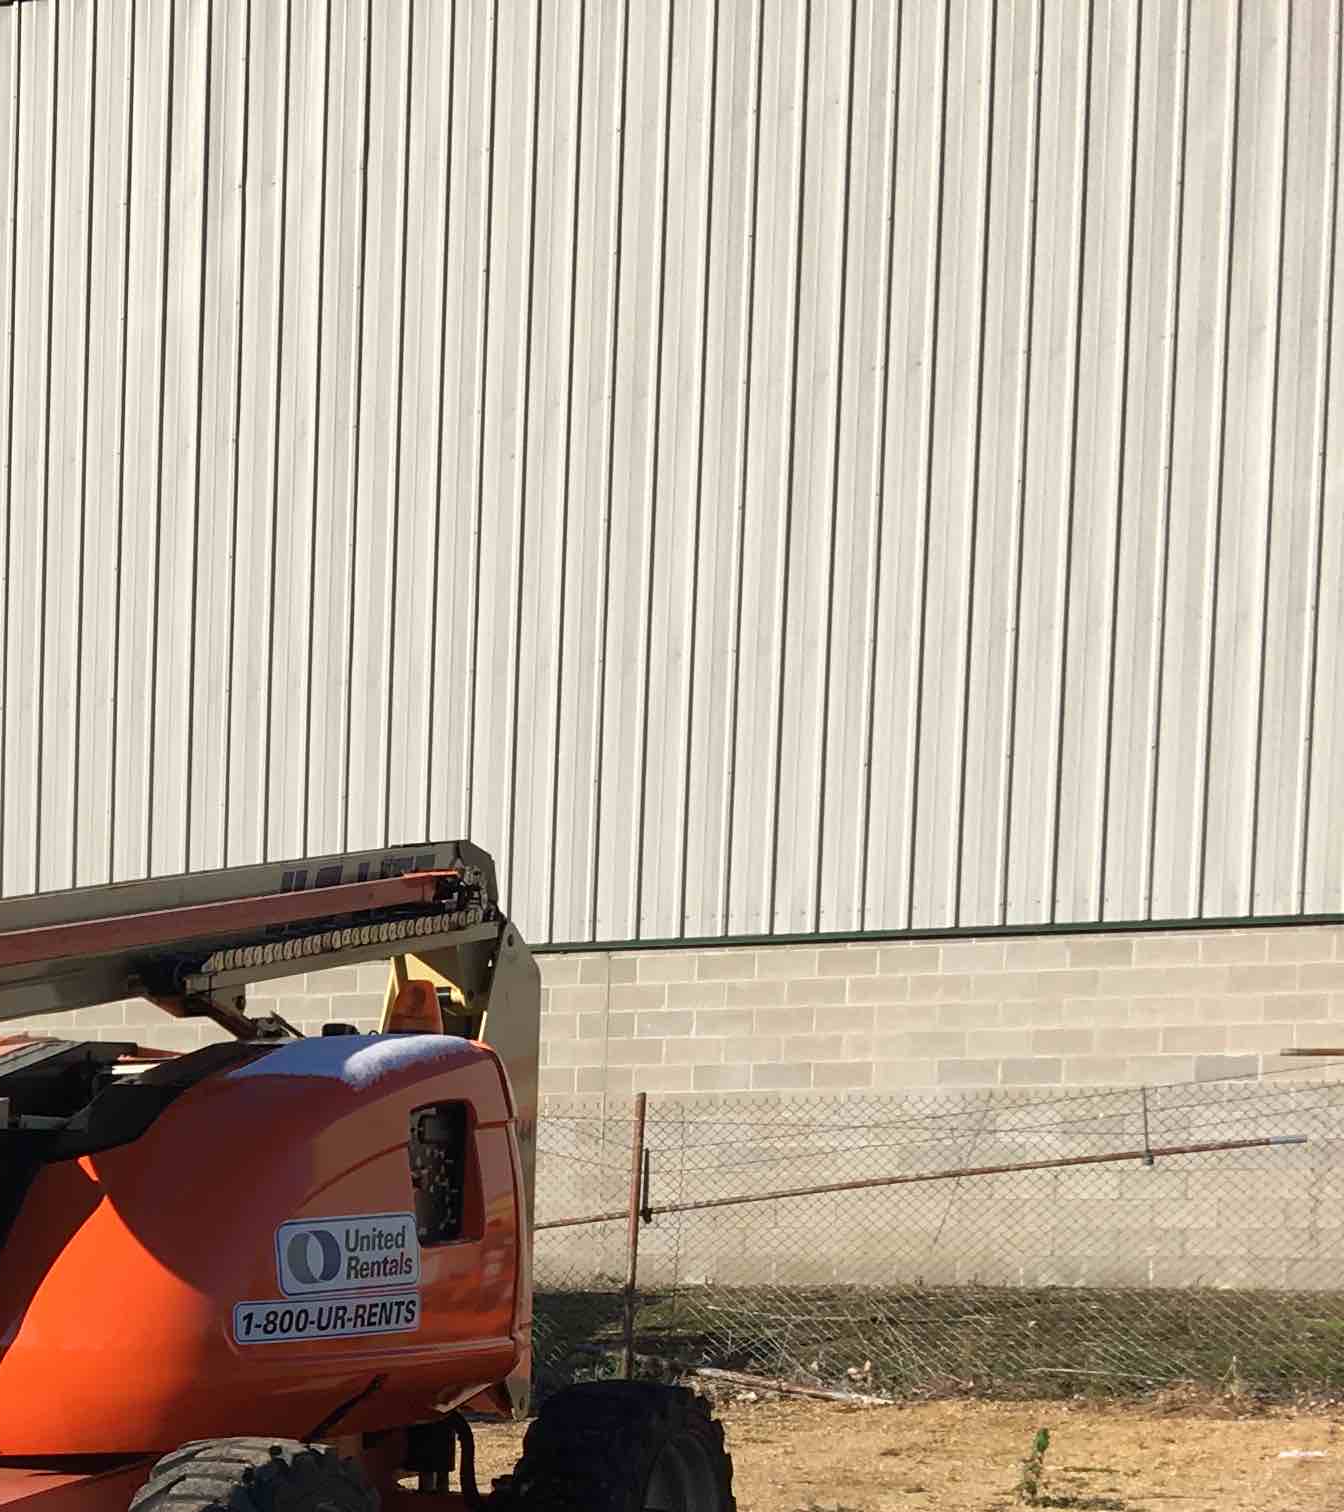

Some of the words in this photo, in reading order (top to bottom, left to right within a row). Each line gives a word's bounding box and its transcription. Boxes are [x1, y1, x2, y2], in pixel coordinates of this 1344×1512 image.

[345, 1225, 406, 1252] United
[345, 1252, 413, 1281] Rentals
[241, 1299, 417, 1336] 1-800-UR-RENTS
